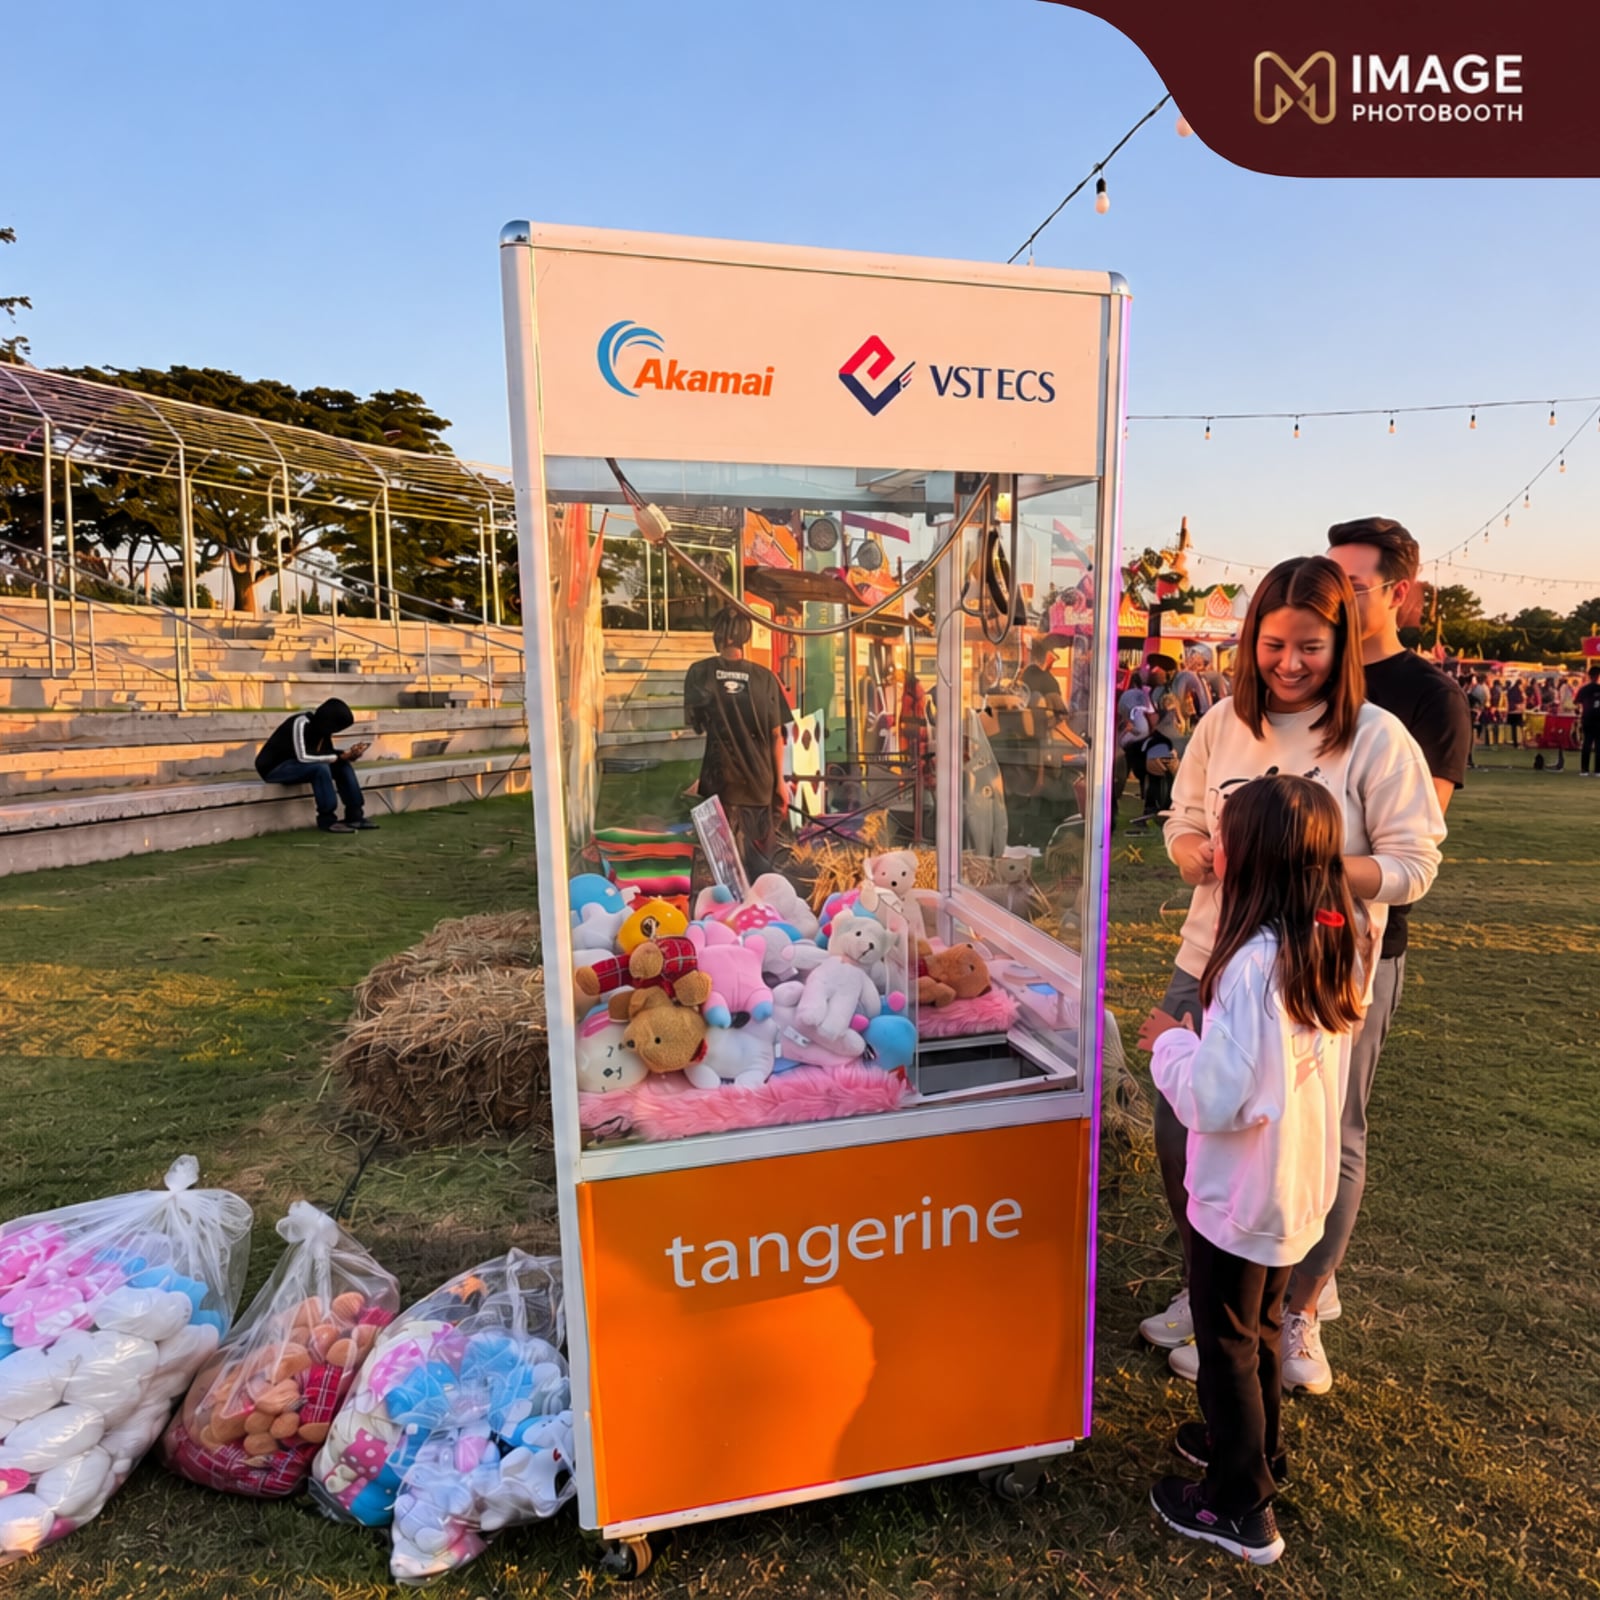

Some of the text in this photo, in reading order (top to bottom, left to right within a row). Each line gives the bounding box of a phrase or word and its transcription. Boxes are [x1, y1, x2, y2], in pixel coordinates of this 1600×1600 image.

[633, 358, 775, 397] Akamai
[929, 365, 1056, 403] VSTECS
[665, 1196, 1022, 1288] tangerine
